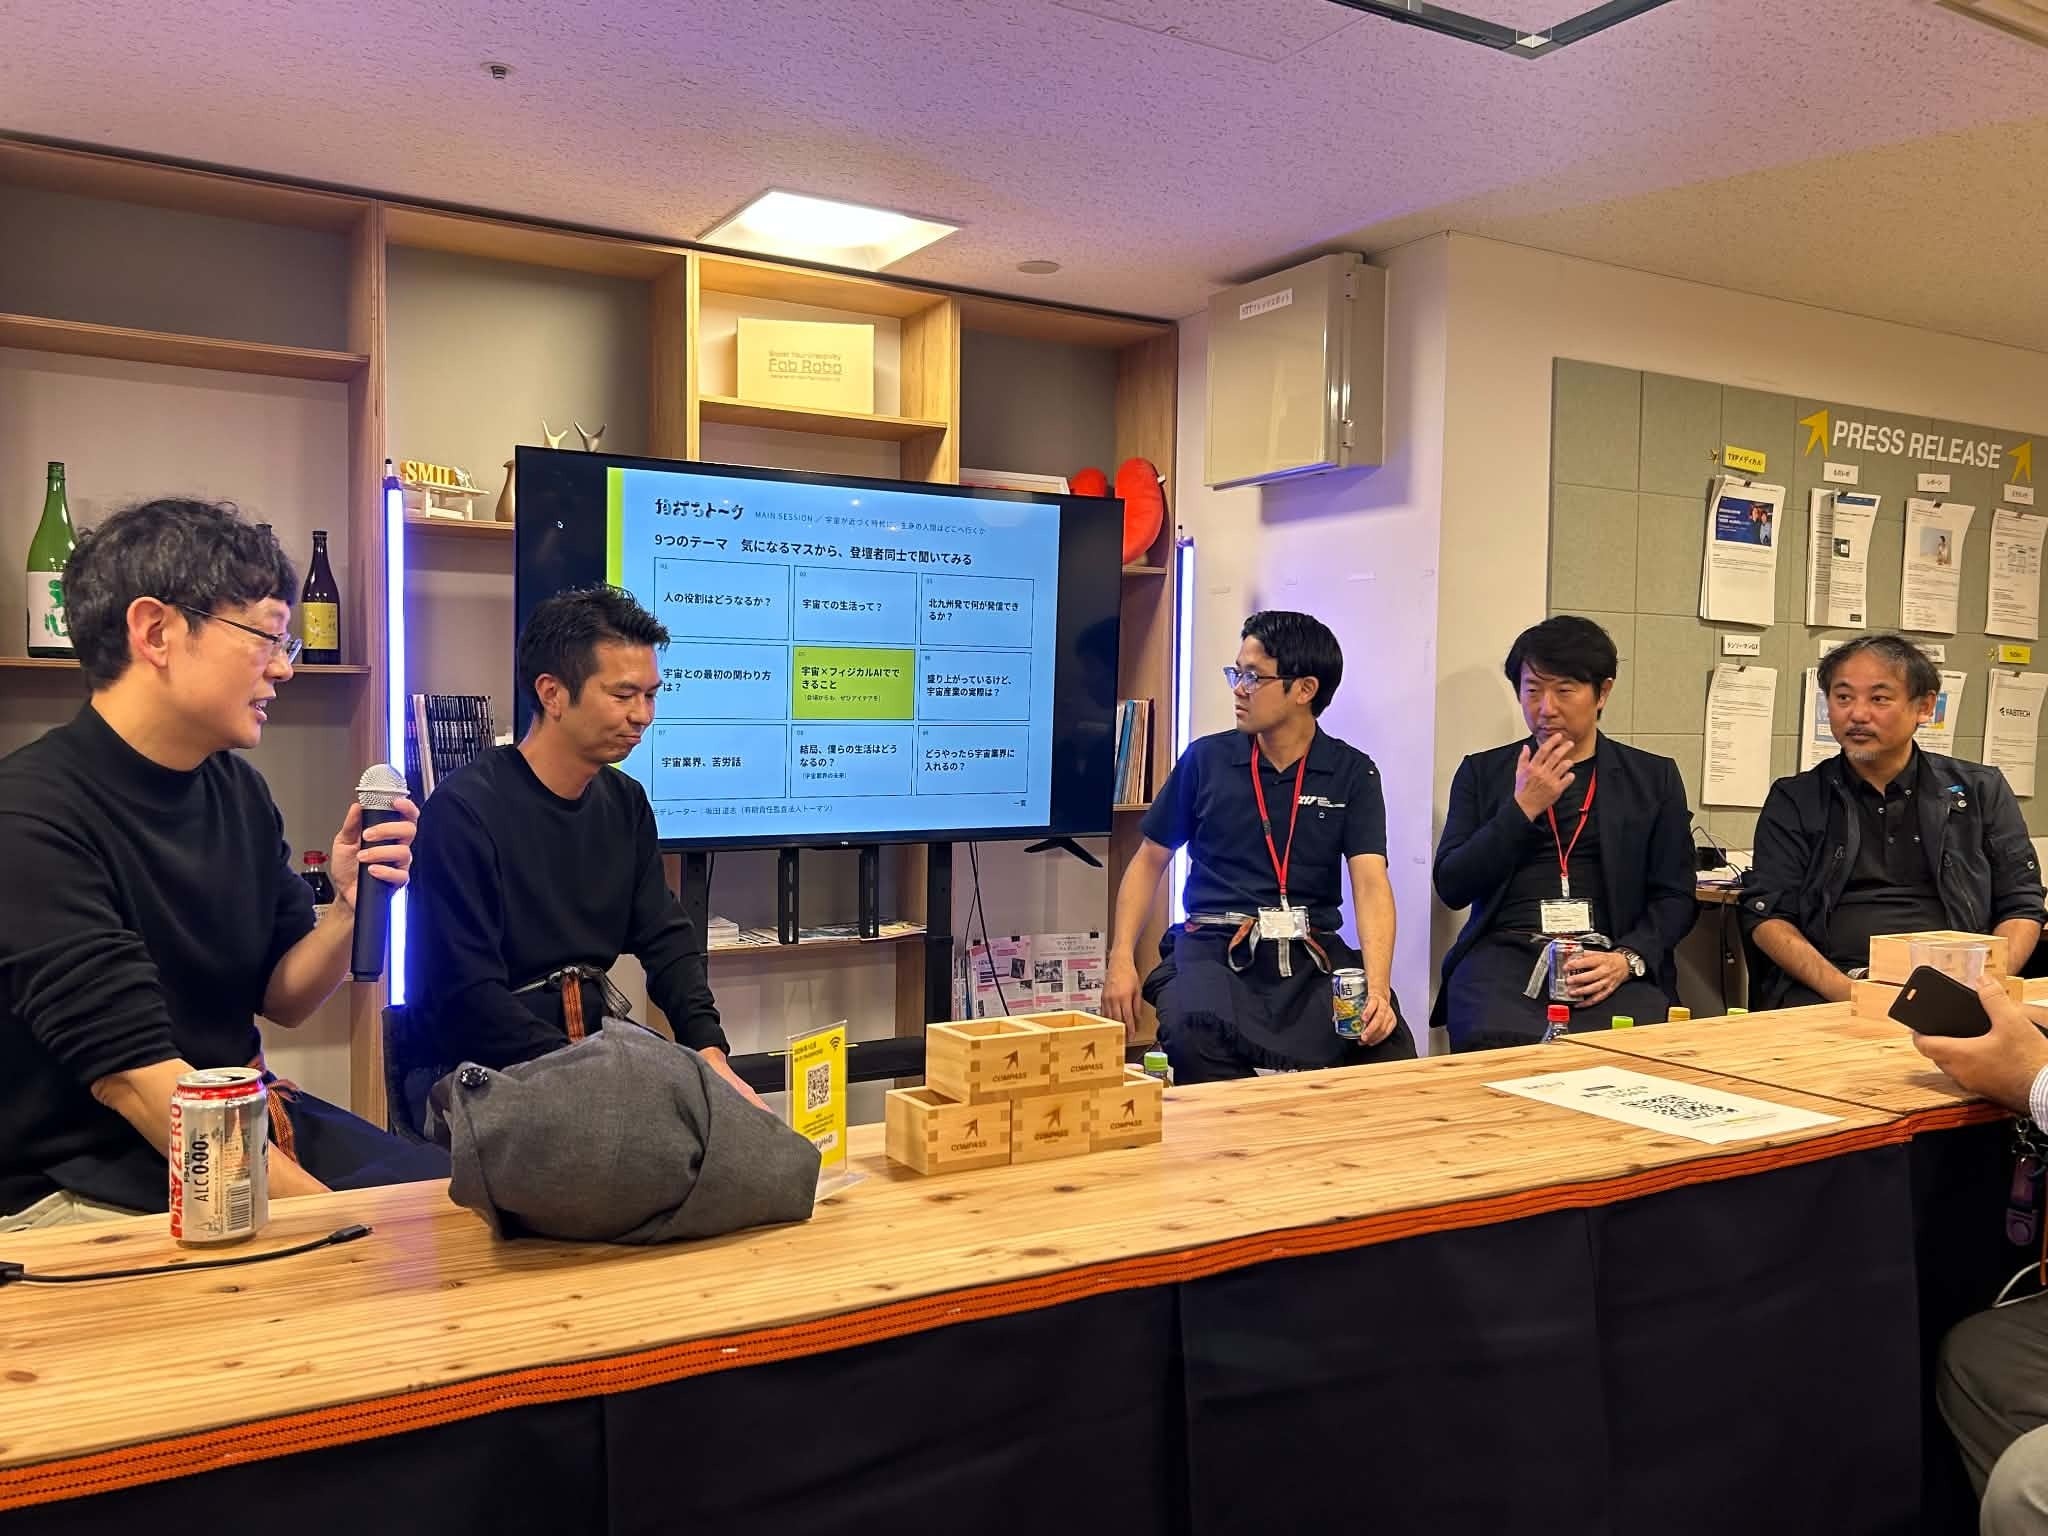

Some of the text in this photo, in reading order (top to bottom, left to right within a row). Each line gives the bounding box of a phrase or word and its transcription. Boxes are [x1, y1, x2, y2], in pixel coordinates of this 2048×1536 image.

[767, 358, 798, 372] Fab
[1832, 420, 2003, 469] PRESS RELEASE
[755, 511, 777, 520] MAIN
[778, 512, 813, 523] SESSION
[654, 533, 973, 566] 9つのテーマ 気になるマスから、登壇者同士で聞いてみる
[663, 592, 771, 607] 人の役割はどうなるか？
[802, 598, 883, 612] 宇宙での生活って？
[928, 598, 1020, 612] 北九州発で何が発信でき
[928, 611, 953, 622] るか？
[663, 668, 772, 681] 宇宙との最初の関わり方
[801, 666, 900, 678] 宇宙×フィジカルAIでで
[801, 679, 838, 690] きること
[927, 674, 1012, 686] 盛り上がっているけど、
[663, 682, 681, 692] は？
[799, 744, 898, 755] 結局、僕らの生活はどう
[925, 748, 1016, 759] どうやったら宇宙業界に
[661, 756, 742, 768] 宇宙業界、苦労話
[799, 758, 835, 768] なるの？
[924, 761, 966, 772] 入れるの？
[1070, 1063, 1104, 1073] COMPASS
[992, 1072, 1028, 1082] COMPASS
[1110, 1119, 1143, 1130] COMPASS
[1034, 1128, 1069, 1141] COMPASS
[951, 1140, 988, 1152] COMPASS
[170, 1103, 184, 1239] DRY ZERO
